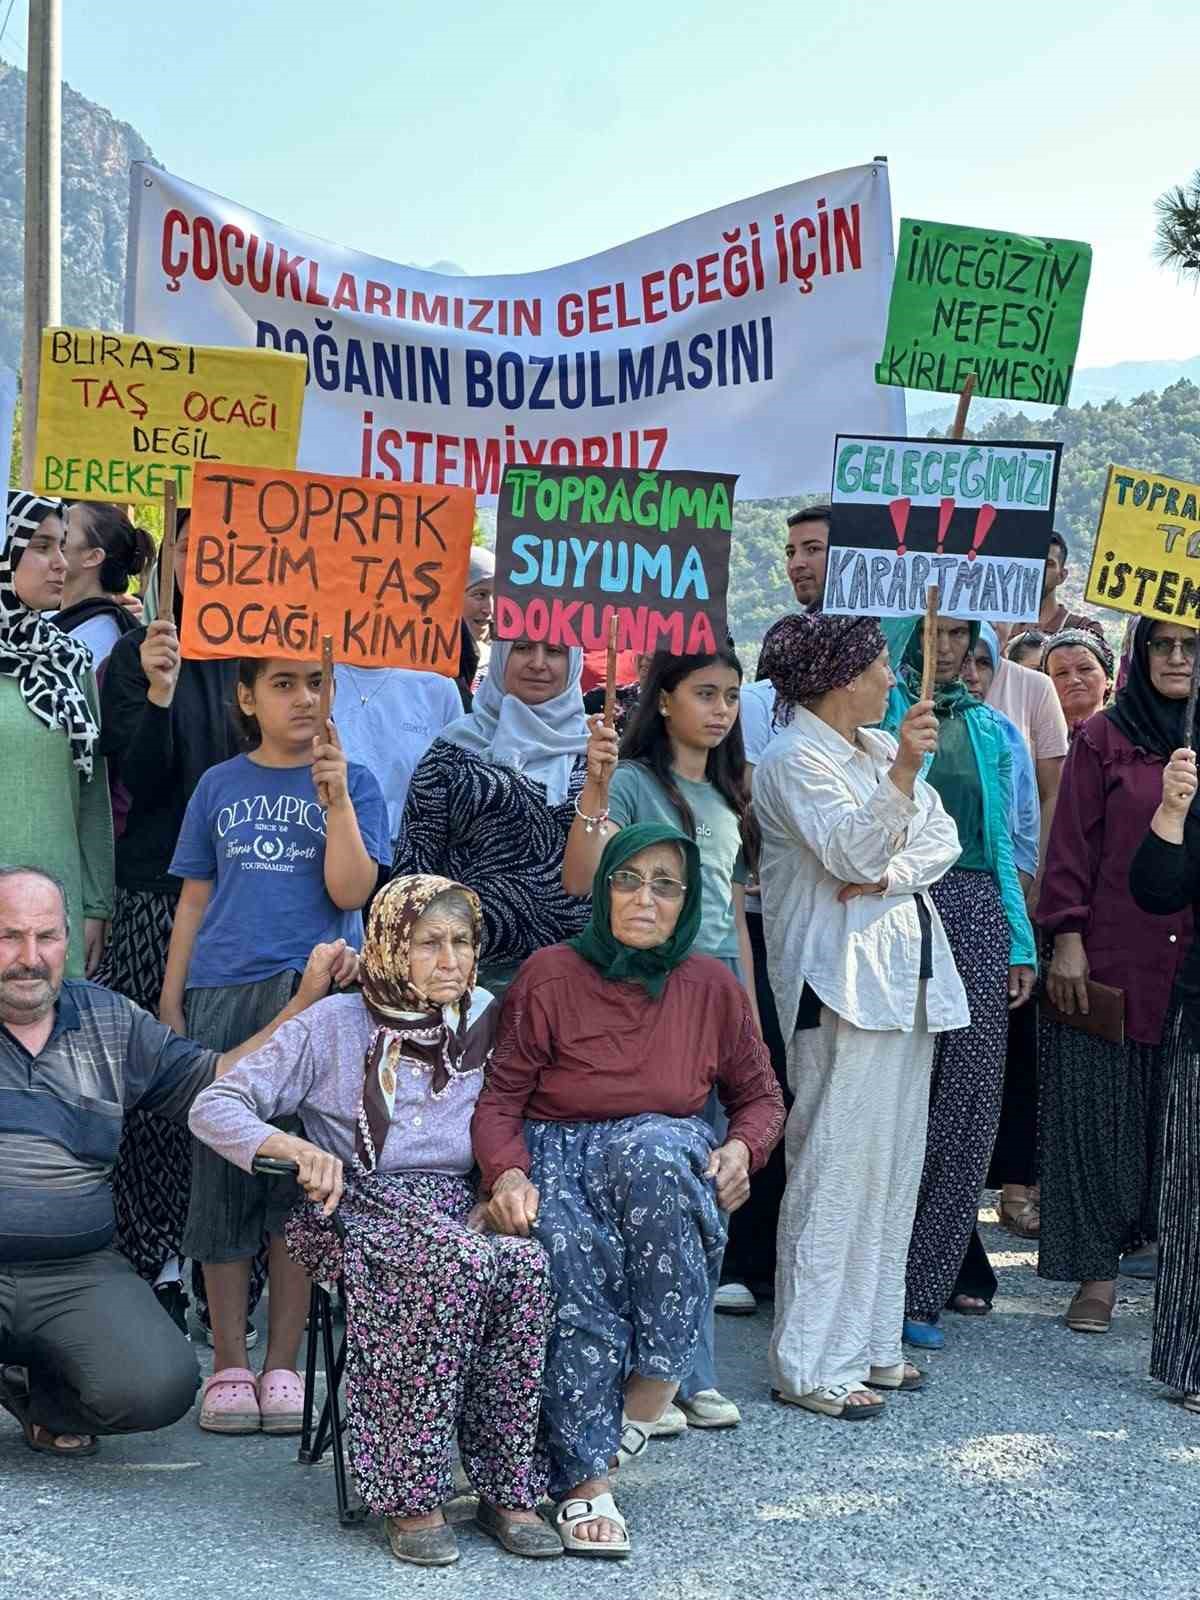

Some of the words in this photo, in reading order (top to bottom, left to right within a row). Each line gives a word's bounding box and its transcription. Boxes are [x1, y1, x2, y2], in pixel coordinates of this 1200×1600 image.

[161, 209, 542, 337] ÇOCUKLARIMIZIN
[557, 222, 765, 338] GELECEĞİ
[774, 198, 863, 294] İÇİN
[907, 225, 1079, 302] İNCEĞİZİN
[51, 330, 196, 374] BURASI
[933, 297, 1057, 356] NEFESİ
[465, 316, 774, 410] BOZULMASINI
[887, 339, 1074, 406] KİRLENMESİN
[71, 378, 149, 420] TAŞ
[184, 390, 278, 431] OCAĞI
[133, 425, 222, 460] DEĞİL
[45, 455, 192, 500] BEREKET
[505, 468, 735, 532] TOPRAĞIMA
[836, 443, 1053, 507] GELECEĞİMİZİ
[1114, 474, 1200, 521] TOPRA
[206, 474, 450, 551] TOPRAK
[195, 529, 320, 590] BİZİM
[351, 555, 442, 615] TAŞ
[509, 534, 709, 600] SUYUMA
[826, 549, 1040, 616] KARARTMAYIN
[197, 601, 320, 652] OCAĞI
[343, 602, 460, 665] KİMİN
[496, 596, 717, 657] DOKUNMA
[241, 862, 296, 873] TOURNAMENT
